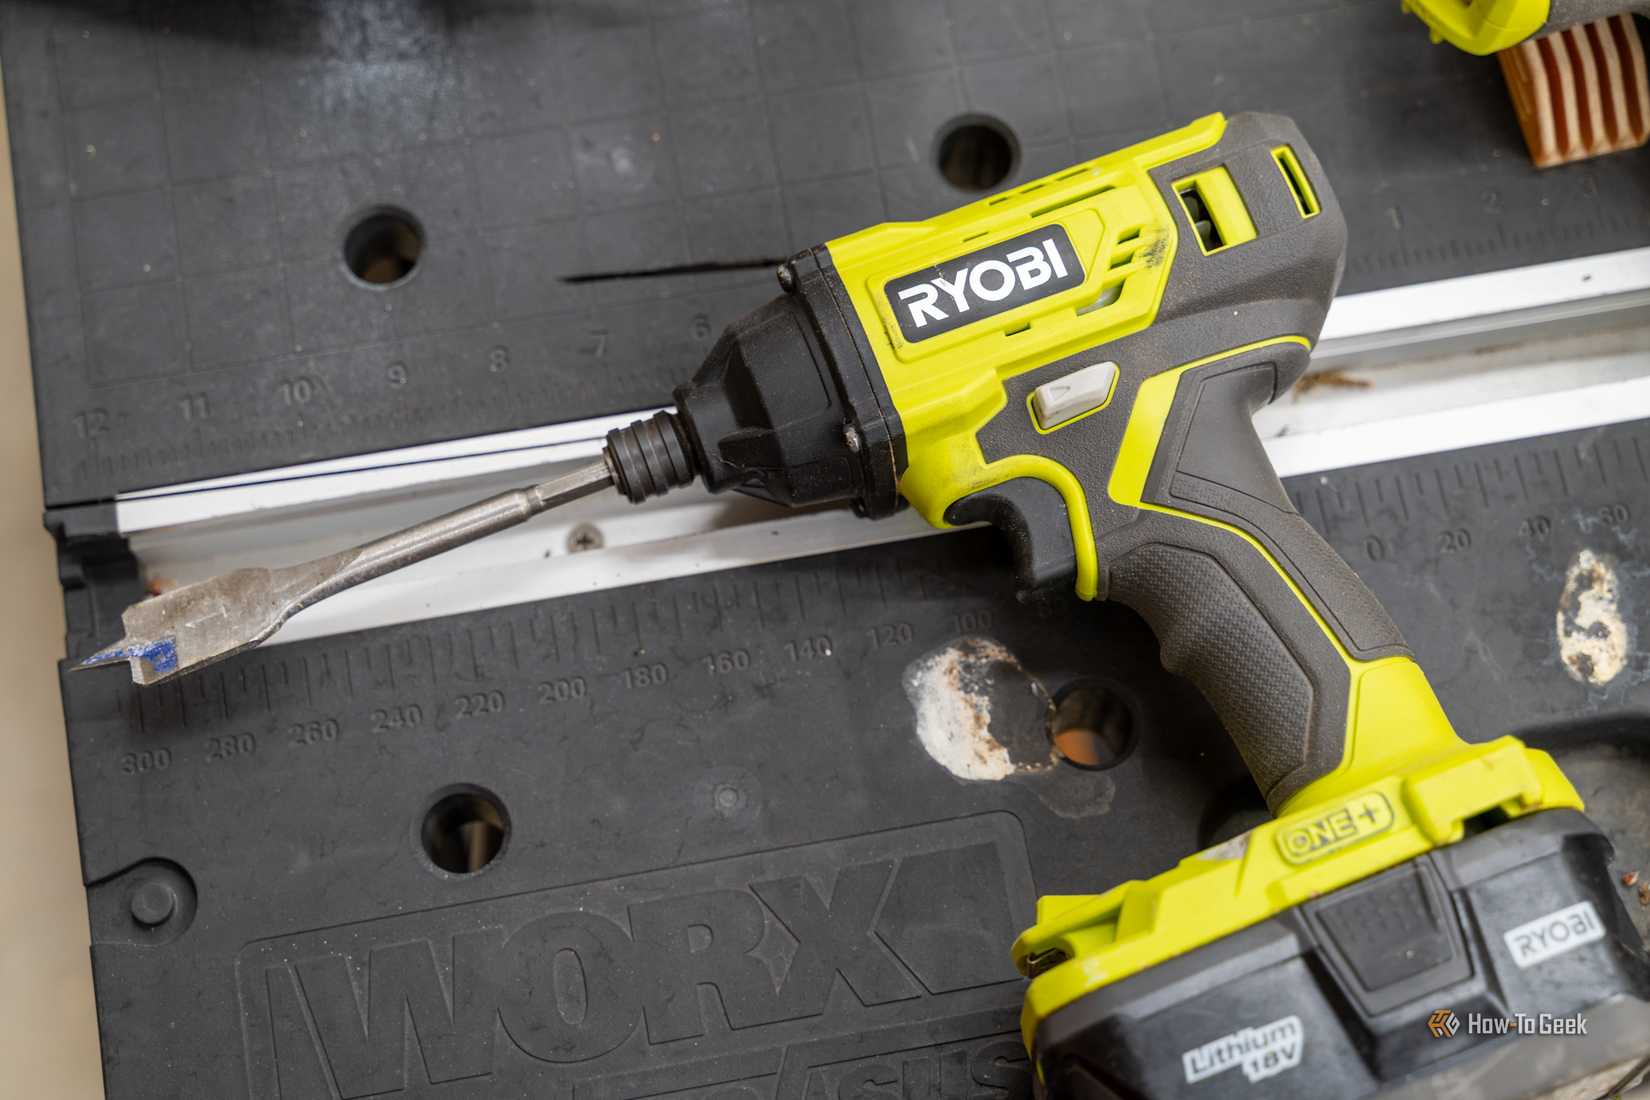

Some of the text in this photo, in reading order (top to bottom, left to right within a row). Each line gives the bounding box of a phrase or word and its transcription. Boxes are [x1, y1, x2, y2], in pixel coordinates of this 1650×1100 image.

[897, 238, 1069, 328] RYOBI
[180, 392, 211, 422] 11
[276, 375, 315, 406] 10
[385, 359, 409, 389] 9
[489, 345, 510, 373] 8
[587, 328, 608, 357] 7
[1363, 534, 1387, 562] 0
[1439, 527, 1473, 555] 20
[1518, 514, 1553, 540] 40
[120, 747, 172, 776] 300
[288, 717, 341, 747] 260
[370, 703, 424, 734] 240
[455, 689, 506, 719] 220
[537, 675, 587, 705] 200
[621, 662, 669, 690] 180
[702, 650, 751, 676] 160
[784, 634, 833, 663] 140
[865, 622, 914, 650] 120
[951, 608, 994, 635] 100
[1282, 799, 1380, 858] ONE+
[1513, 909, 1595, 958] RYOBI
[291, 855, 926, 1100] WORX
[1189, 1021, 1297, 1075] Lithium
[1251, 1042, 1297, 1073] 18V
